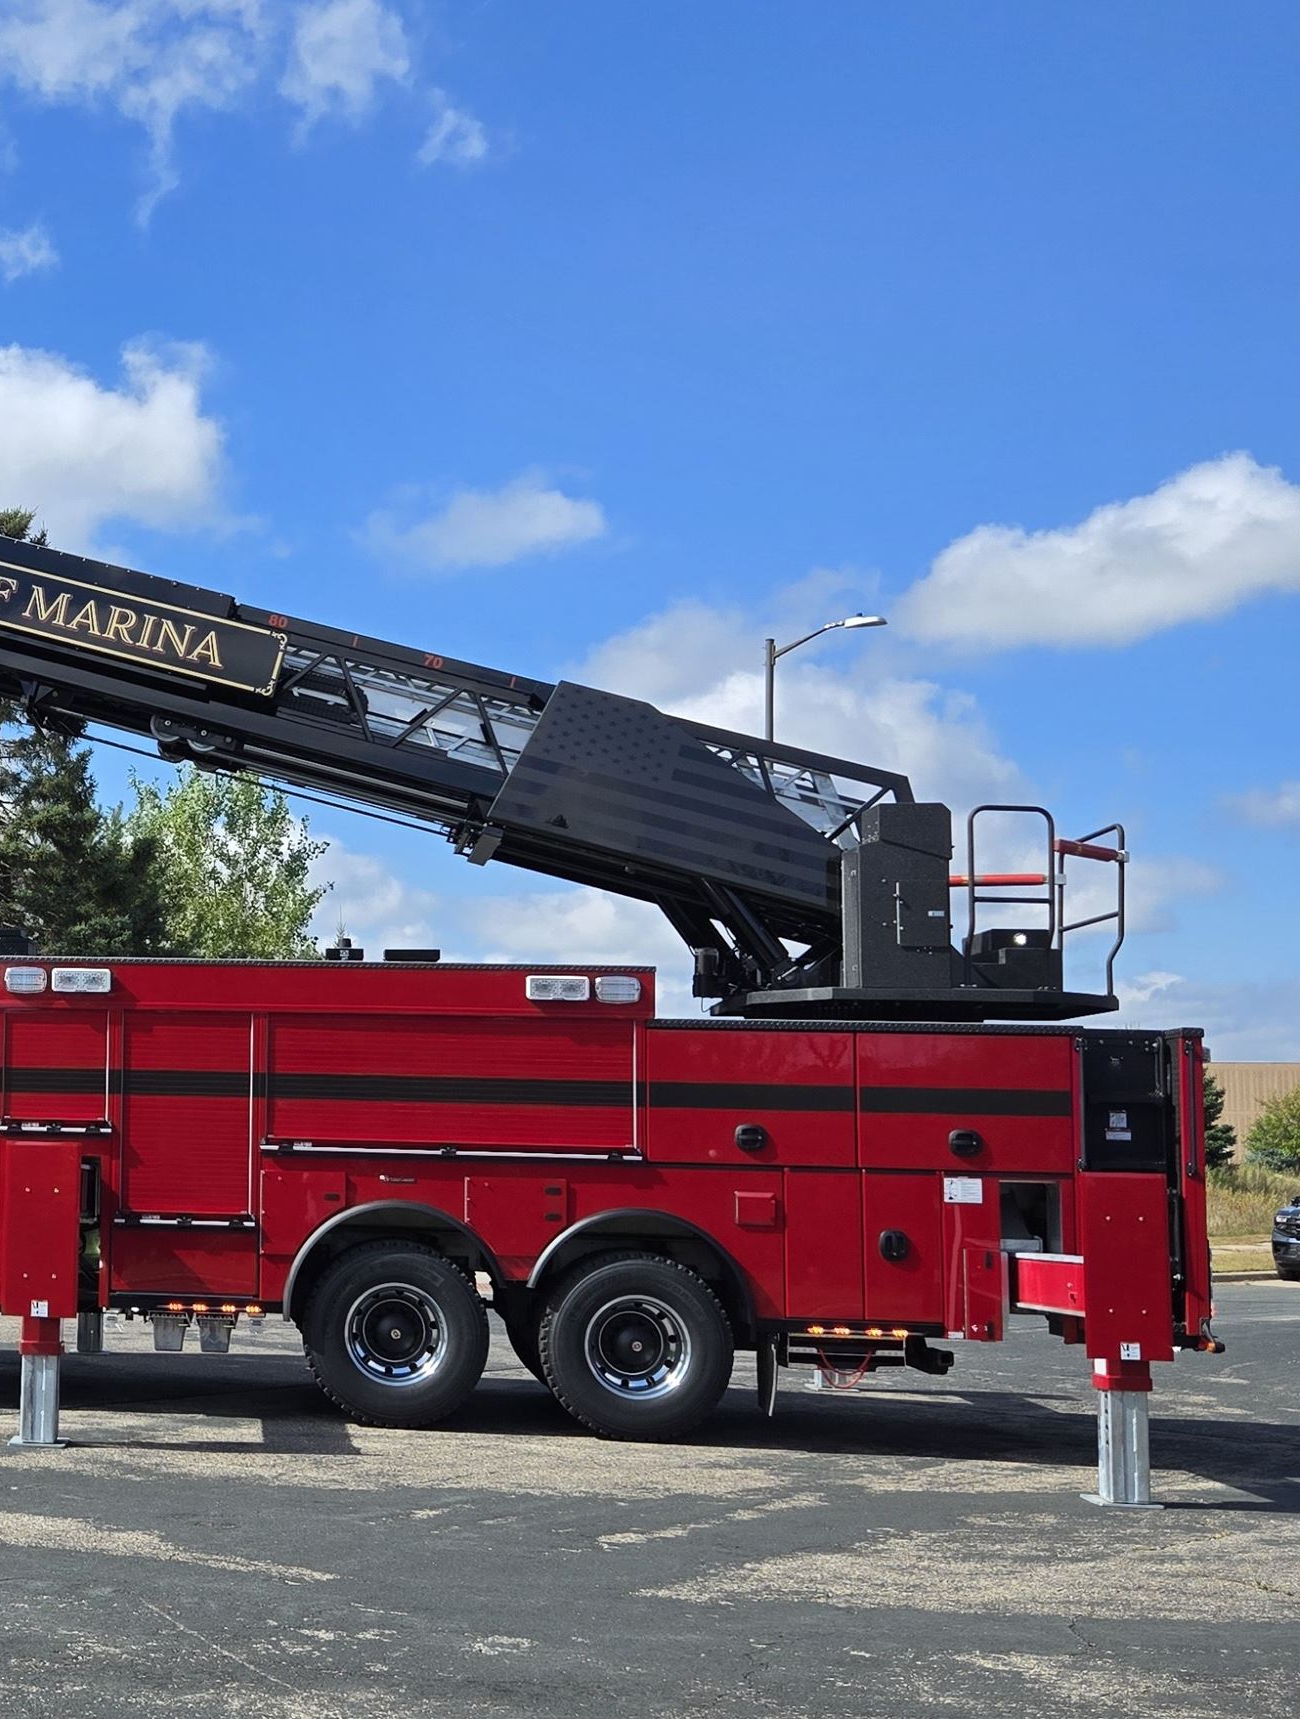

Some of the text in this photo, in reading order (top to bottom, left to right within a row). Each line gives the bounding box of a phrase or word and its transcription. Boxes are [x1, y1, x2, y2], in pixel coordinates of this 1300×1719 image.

[21, 584, 224, 669] MARINA
[267, 614, 289, 629] 80
[424, 654, 445, 670] 70
